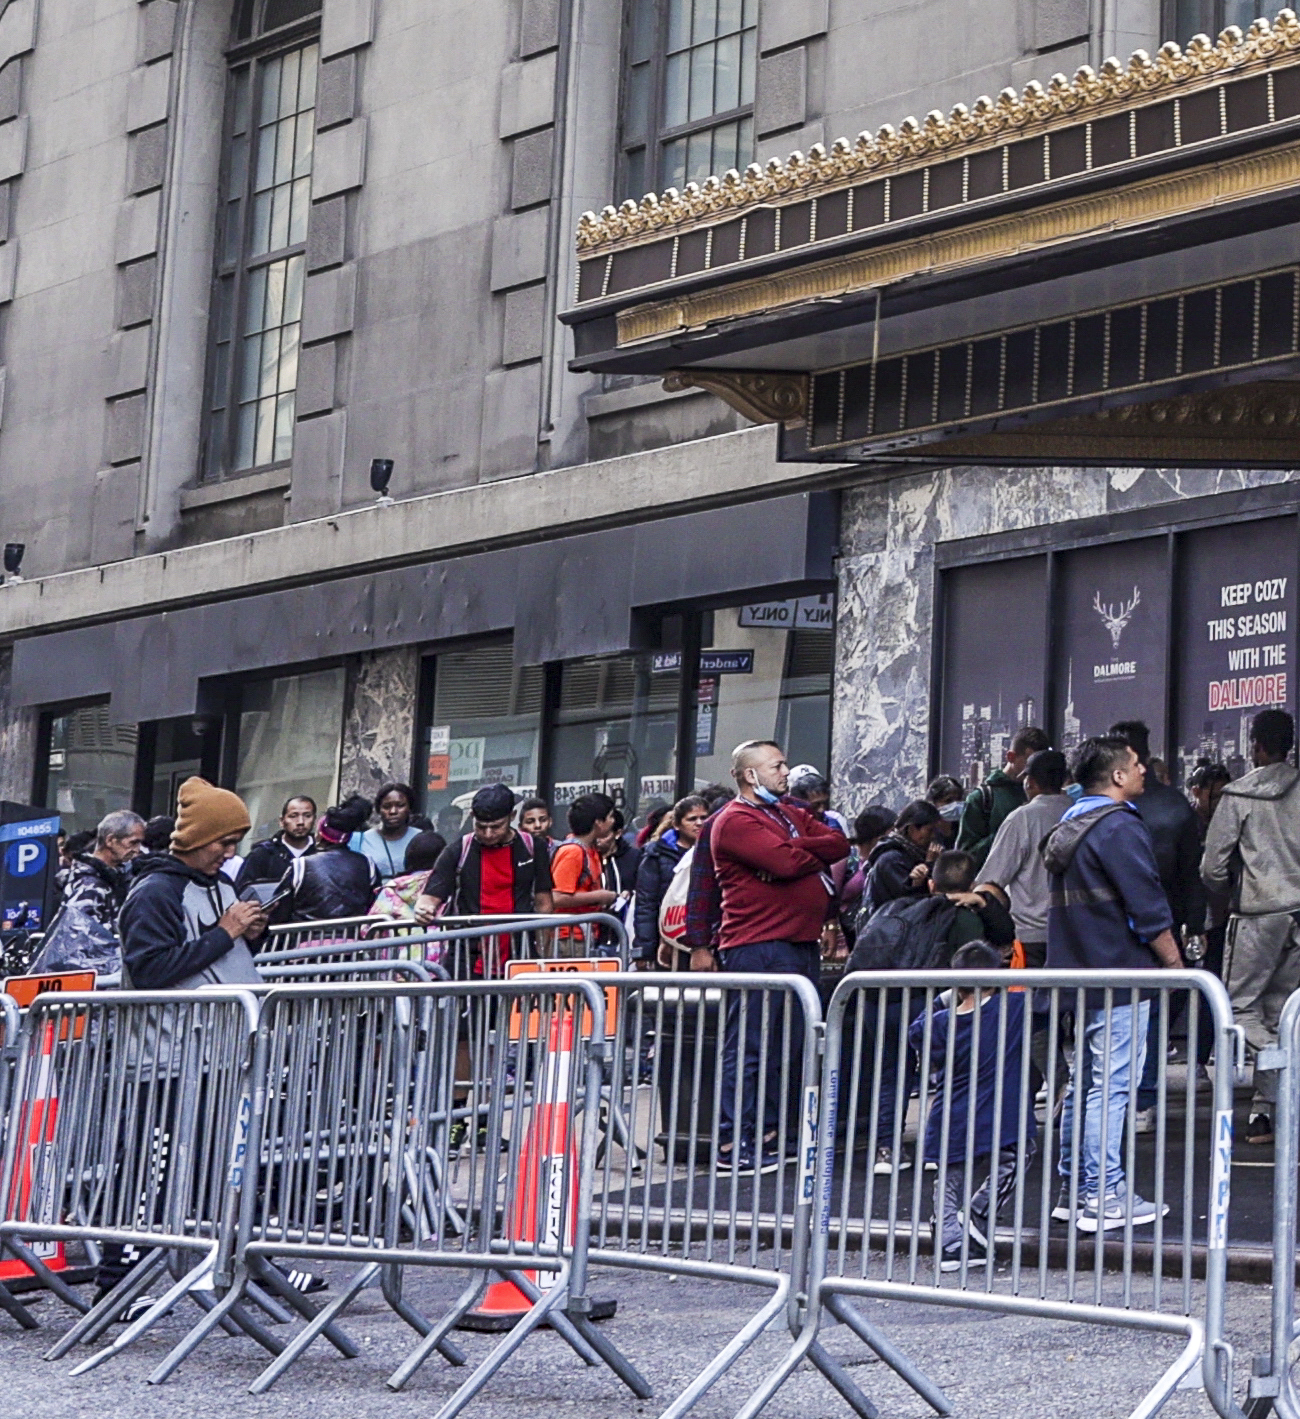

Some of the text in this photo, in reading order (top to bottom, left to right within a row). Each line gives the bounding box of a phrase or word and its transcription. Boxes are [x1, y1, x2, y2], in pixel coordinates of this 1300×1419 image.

[1221, 578, 1287, 607] KEEP COZY
[1207, 611, 1286, 641] THIS SEASON
[1093, 661, 1137, 677] DALMORE
[1228, 644, 1286, 671] WITH THE
[1209, 673, 1287, 711] DALMORE
[18, 843, 39, 872] P
[664, 905, 687, 926] NIK
[37, 979, 62, 995] NO
